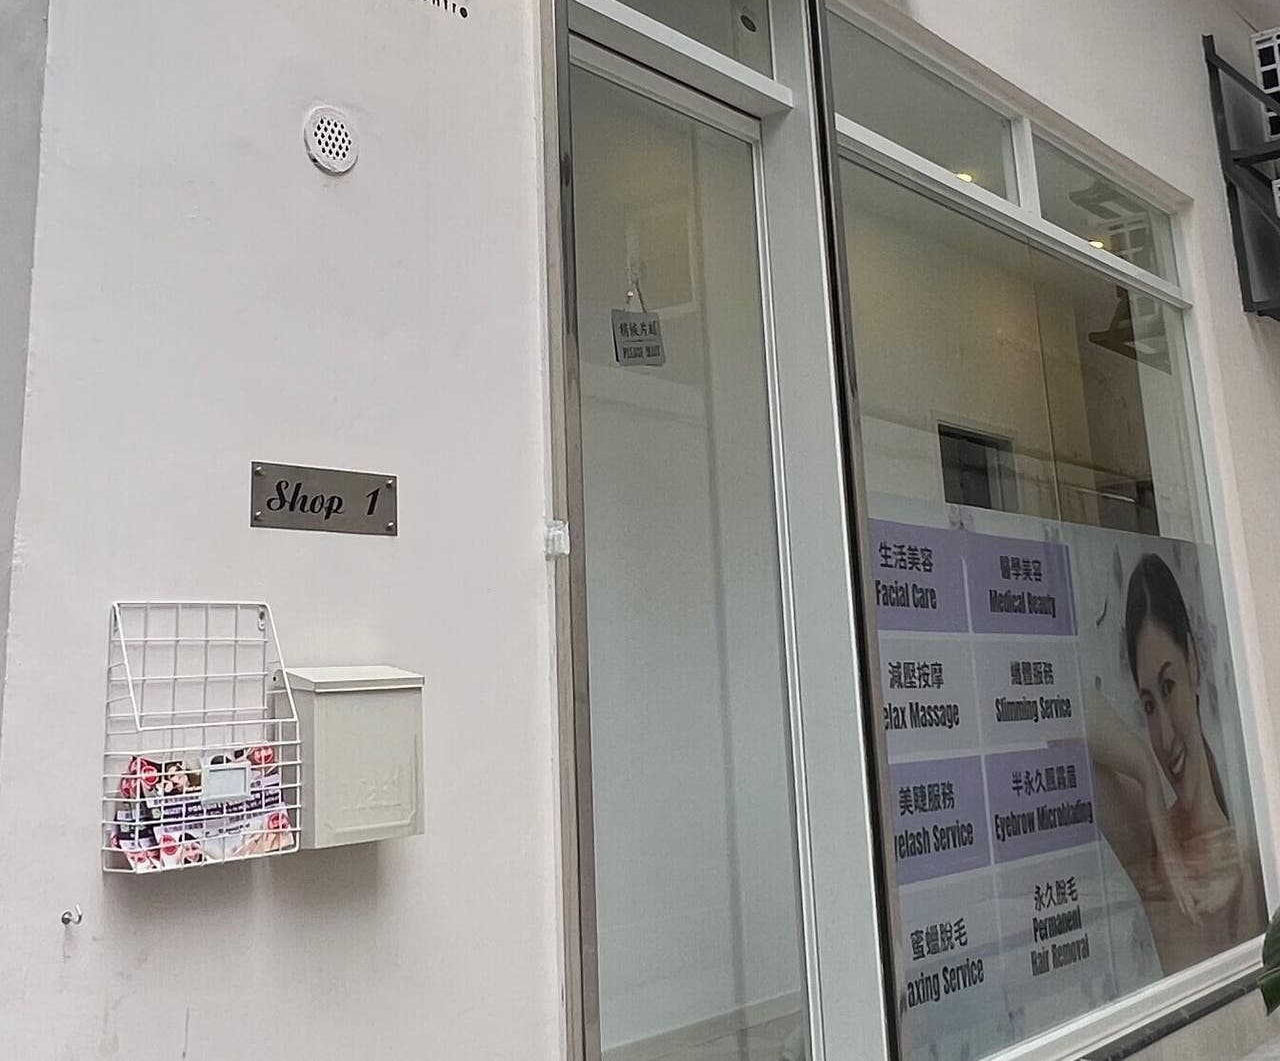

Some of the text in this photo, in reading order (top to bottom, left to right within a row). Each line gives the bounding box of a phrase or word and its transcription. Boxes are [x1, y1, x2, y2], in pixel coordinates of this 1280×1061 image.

[266, 479, 381, 521] Shop 1
[878, 541, 934, 573] 生活美容
[999, 554, 1043, 583] 醫學美容
[875, 580, 937, 609] Facial Care
[989, 589, 1057, 618] Medical Beauty
[888, 661, 944, 689] 減壓按摩
[883, 701, 960, 730] elax Massage
[995, 694, 1072, 722] Slimming Service
[899, 780, 955, 816] 美睫服務
[933, 820, 974, 854] Service
[994, 800, 1093, 842] Eyebrow Microblading
[1034, 876, 1079, 912] 永久脫毛
[1032, 905, 1082, 943] Permanent
[1031, 936, 1091, 976] Hair Removal
[907, 957, 985, 1008] axing Service
